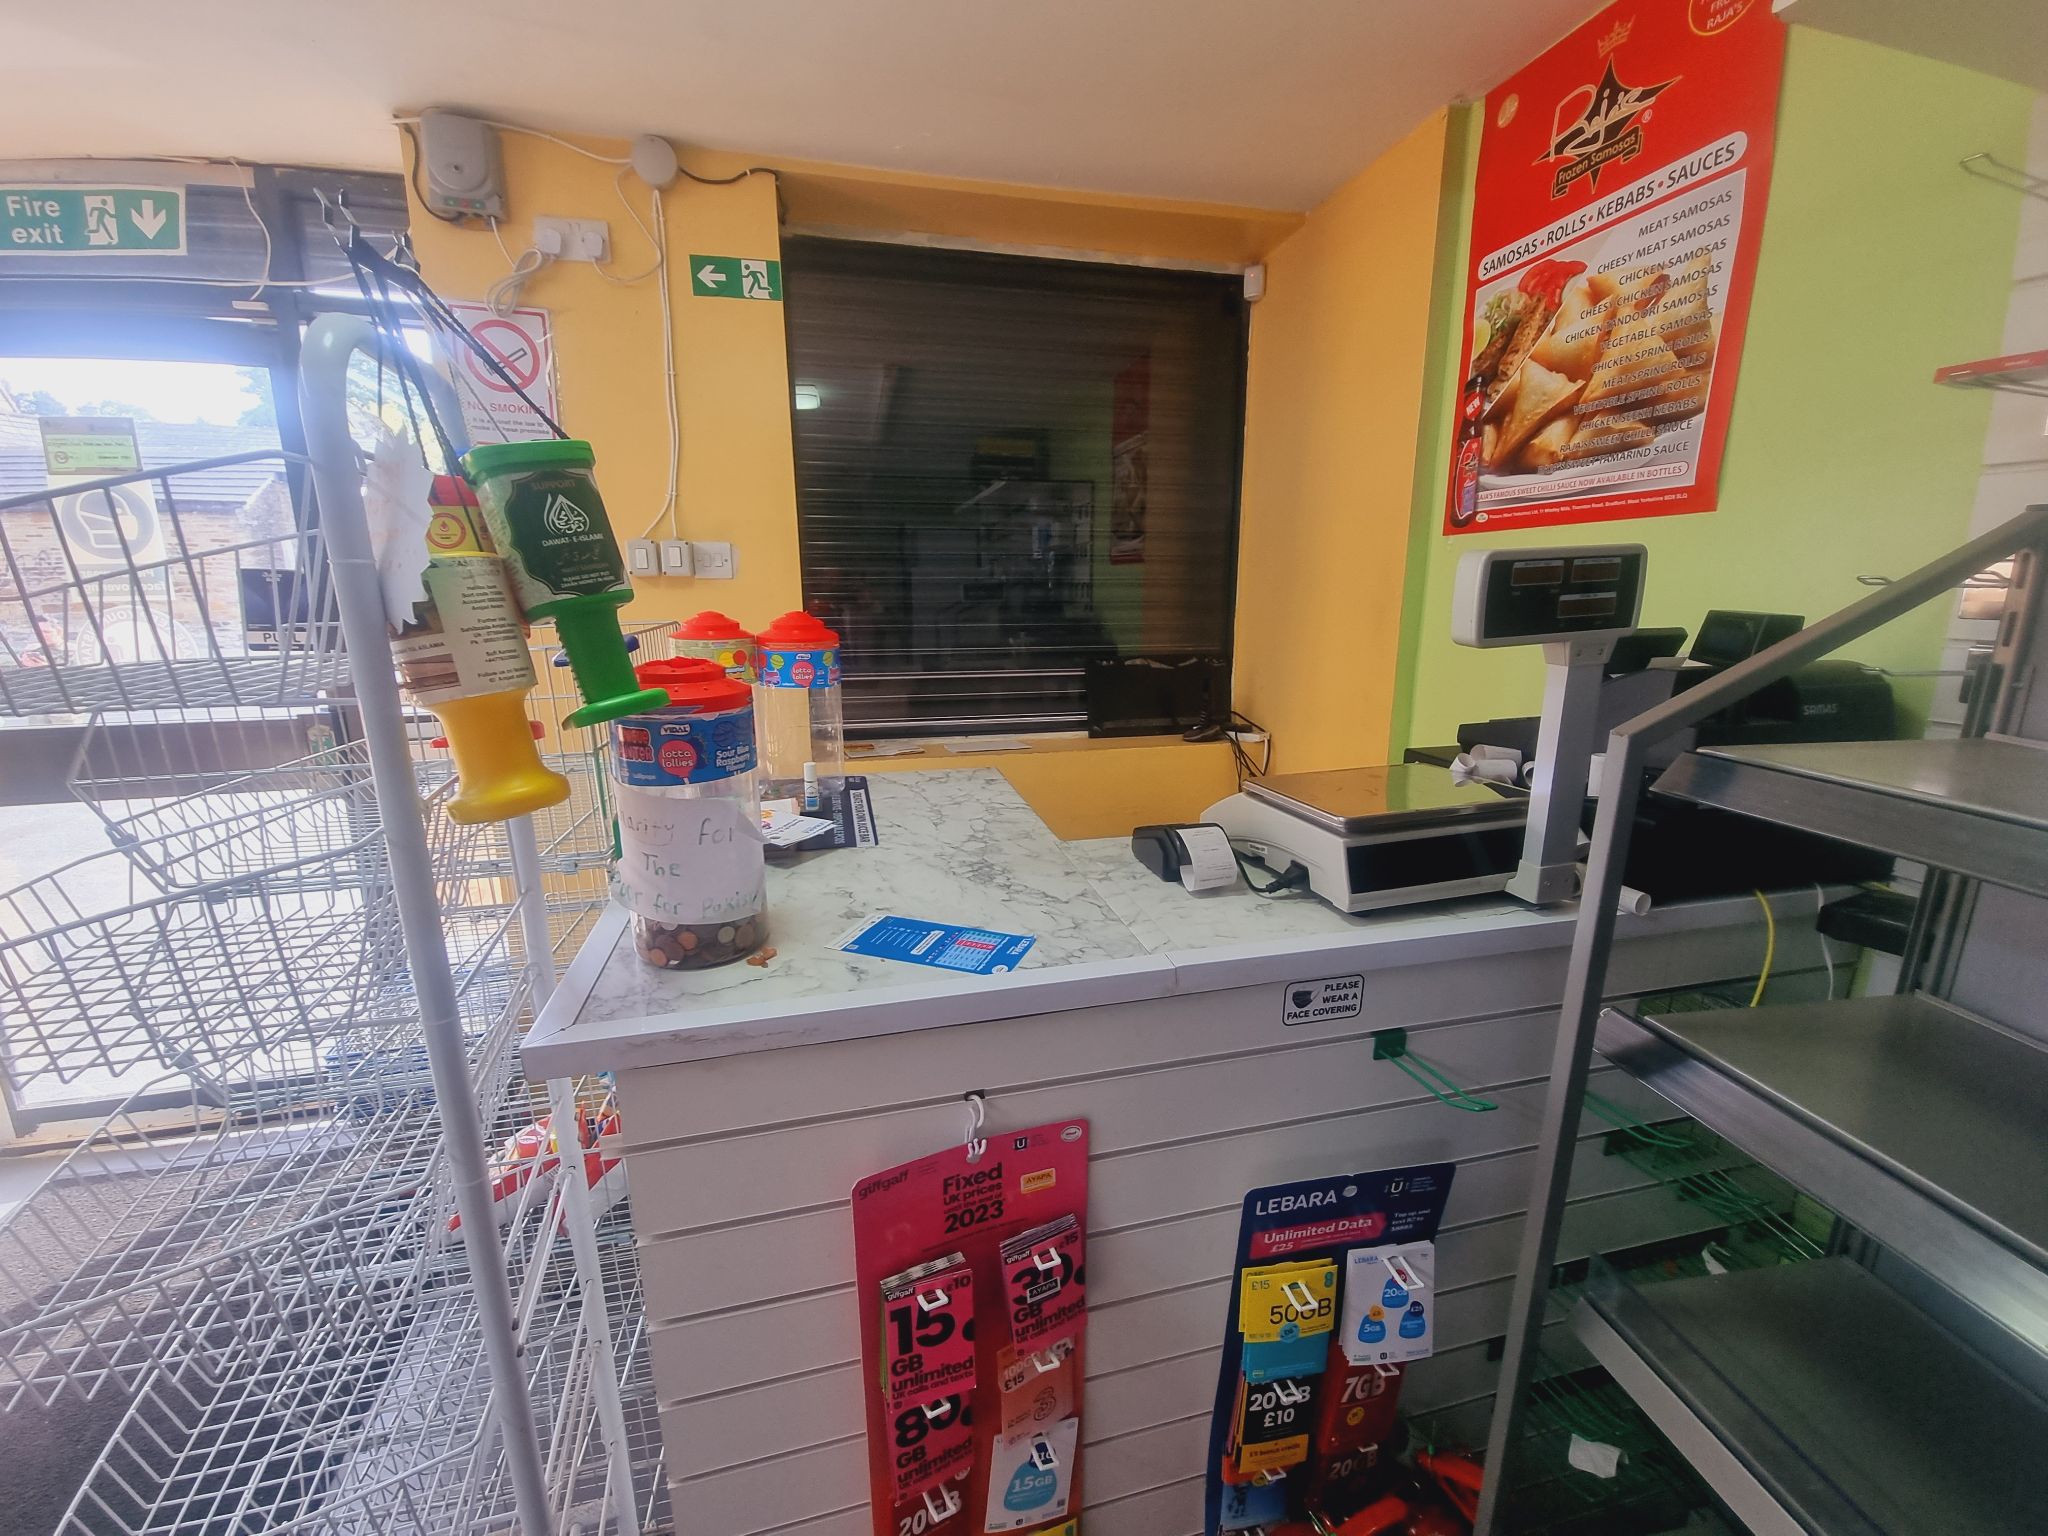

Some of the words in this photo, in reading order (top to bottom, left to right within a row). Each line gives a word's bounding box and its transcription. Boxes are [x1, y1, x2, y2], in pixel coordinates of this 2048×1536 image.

[1706, 3, 1743, 29] RAJA'S
[1558, 160, 1589, 185] Frozen
[1591, 133, 1636, 165] Samosas
[7, 195, 61, 217] Fire
[1482, 239, 1539, 277] SAMOSAS
[1546, 214, 1587, 246] ROLLS
[1595, 180, 1655, 222] KEBABS
[1666, 142, 1736, 189] SAUCES
[1638, 216, 1670, 238] MEAT
[1672, 190, 1733, 224] SAMOSAS
[11, 223, 65, 244] exit
[1597, 252, 1634, 274] CHEESY
[1636, 238, 1668, 260] MEAT
[1670, 214, 1731, 247] SAMOSAS
[1618, 261, 1666, 286] CHICKEN
[1667, 238, 1728, 269] SAMOSAS
[1580, 302, 1614, 320] CHEESY
[1616, 283, 1666, 307] CHICKEN
[1666, 262, 1723, 290] SAMOSAS
[1565, 325, 1603, 344] CHICKEN
[1606, 306, 1660, 330] TANDOORI
[1662, 284, 1719, 312] SAMOSAS
[1599, 326, 1657, 352] VEGETABLE
[1659, 307, 1715, 334] SAMOSAS
[1591, 355, 1633, 373] CHICKEN
[1635, 343, 1672, 361] SPRING
[1673, 331, 1710, 350] ROLLS
[1602, 374, 1629, 389] MEAT
[1631, 363, 1670, 382] SPRING
[1671, 351, 1707, 370] ROLLS
[1626, 385, 1666, 402] SPRING
[1666, 375, 1702, 391] ROLLS
[1578, 419, 1618, 431] CHICKEN
[1653, 397, 1698, 416] KEBABS
[1590, 434, 1621, 447] SWEET
[1623, 427, 1655, 442] CHILLI
[1655, 419, 1694, 436] SAUCE
[1598, 447, 1651, 465] TAMARIND
[1653, 441, 1691, 456] SAUCE
[1493, 489, 1517, 499] FAMOUS
[1516, 486, 1537, 496] SWEET
[1556, 481, 1577, 491] SAUCE
[1577, 478, 1595, 488] NOW
[1595, 472, 1635, 485] AVAILABLE
[1636, 471, 1645, 479] IN
[1646, 465, 1683, 478] BOTTLES
[263, 632, 301, 643] PUL
[792, 673, 814, 681] lollies
[662, 724, 689, 733] VIDAL
[661, 758, 694, 768] lollies
[662, 749, 692, 758] lotta
[715, 749, 736, 759] Sour
[1322, 995, 1349, 1004] WEAR
[1351, 992, 1358, 1000] A
[1324, 980, 1360, 992] PLEASE
[1287, 1010, 1310, 1021] FACE
[1312, 1004, 1357, 1017] COVERING
[858, 1170, 909, 1201] giffgaff
[943, 1162, 1003, 1196] Fixed
[943, 1192, 961, 1207] UK
[962, 1182, 1003, 1203] prices
[963, 1199, 977, 1208] the
[1255, 1190, 1337, 1216] LEBARA
[944, 1200, 1004, 1235] 2023
[1264, 1222, 1337, 1244] Unlimited
[1337, 1217, 1373, 1232] Data
[1006, 1249, 1031, 1264] giffgaff
[1270, 1242, 1294, 1253] £25
[887, 1287, 915, 1301] giffgaff
[1251, 1280, 1270, 1291] £15
[1013, 1302, 1042, 1324] GB
[1014, 1295, 1086, 1338] unlimited
[1269, 1297, 1332, 1325] 50GB
[890, 1303, 956, 1355] 15
[891, 1354, 924, 1377] GB
[892, 1355, 974, 1393] unlimited
[893, 1390, 906, 1401] UK
[907, 1384, 929, 1397] calls
[930, 1378, 949, 1390] and
[950, 1370, 973, 1384] texts
[1004, 1374, 1025, 1391] £15
[1340, 1372, 1386, 1403] 7GB
[1263, 1408, 1295, 1427] £10
[896, 1445, 927, 1469] GB
[897, 1435, 972, 1483] unlimited
